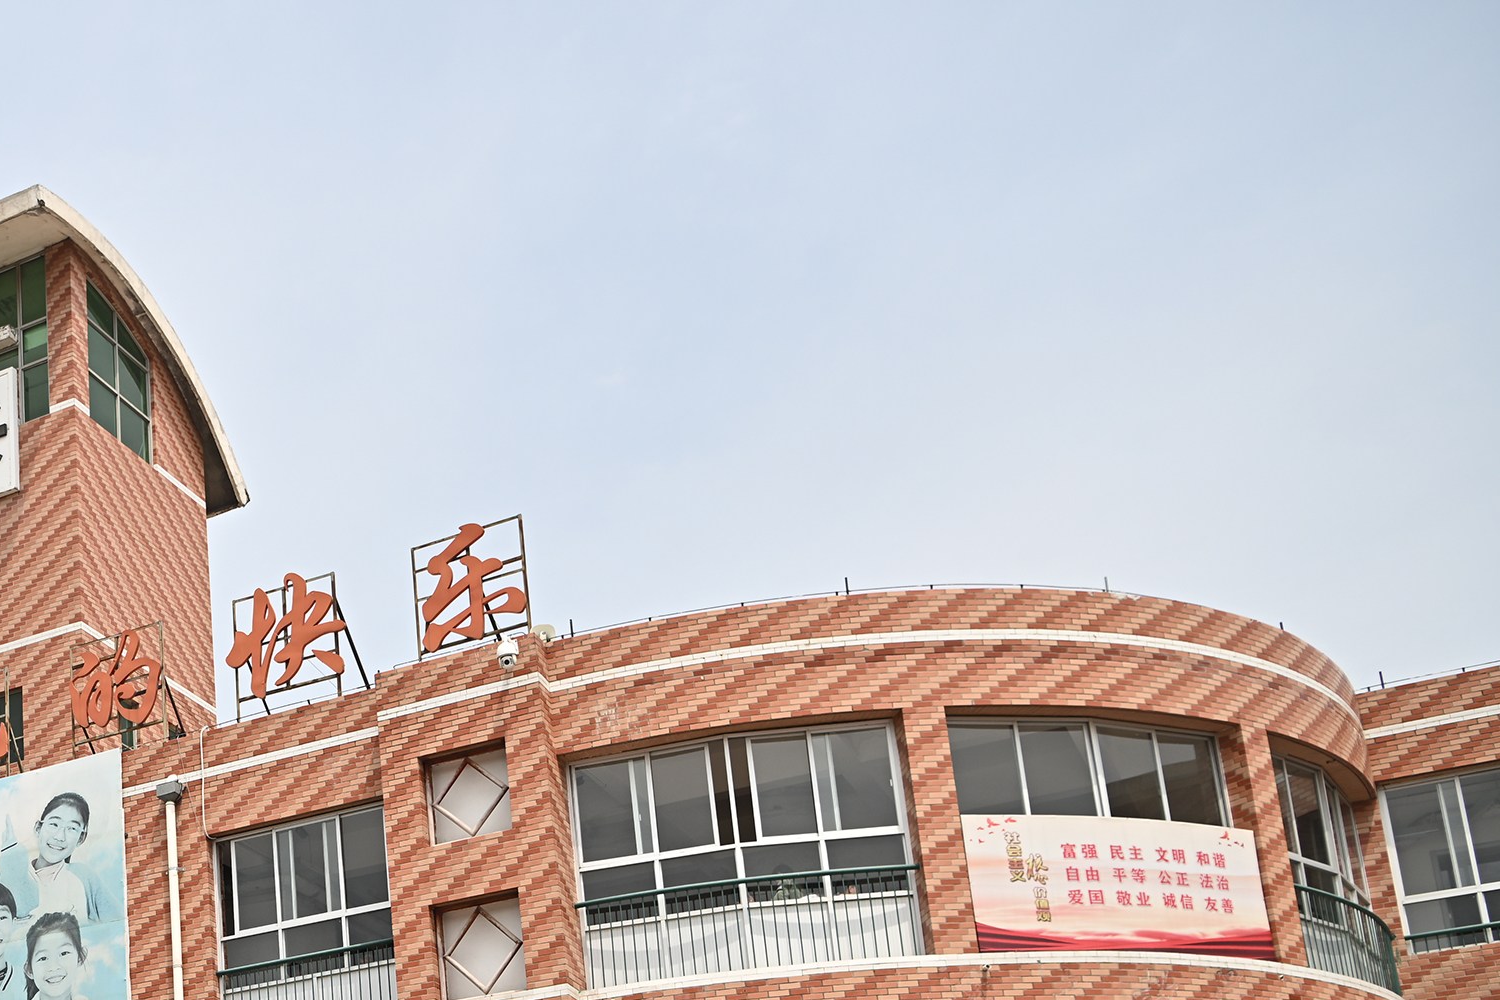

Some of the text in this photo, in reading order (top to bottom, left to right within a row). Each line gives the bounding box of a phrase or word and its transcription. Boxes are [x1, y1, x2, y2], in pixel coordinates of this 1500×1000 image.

[1003, 831, 1026, 882] 社会主义
[1061, 843, 1227, 868] 富强 民主 文明 和谐
[1065, 866, 1230, 891] 自由 平等 公正 法治
[1068, 889, 1234, 914] 爱国 敬业 诚信 友善
